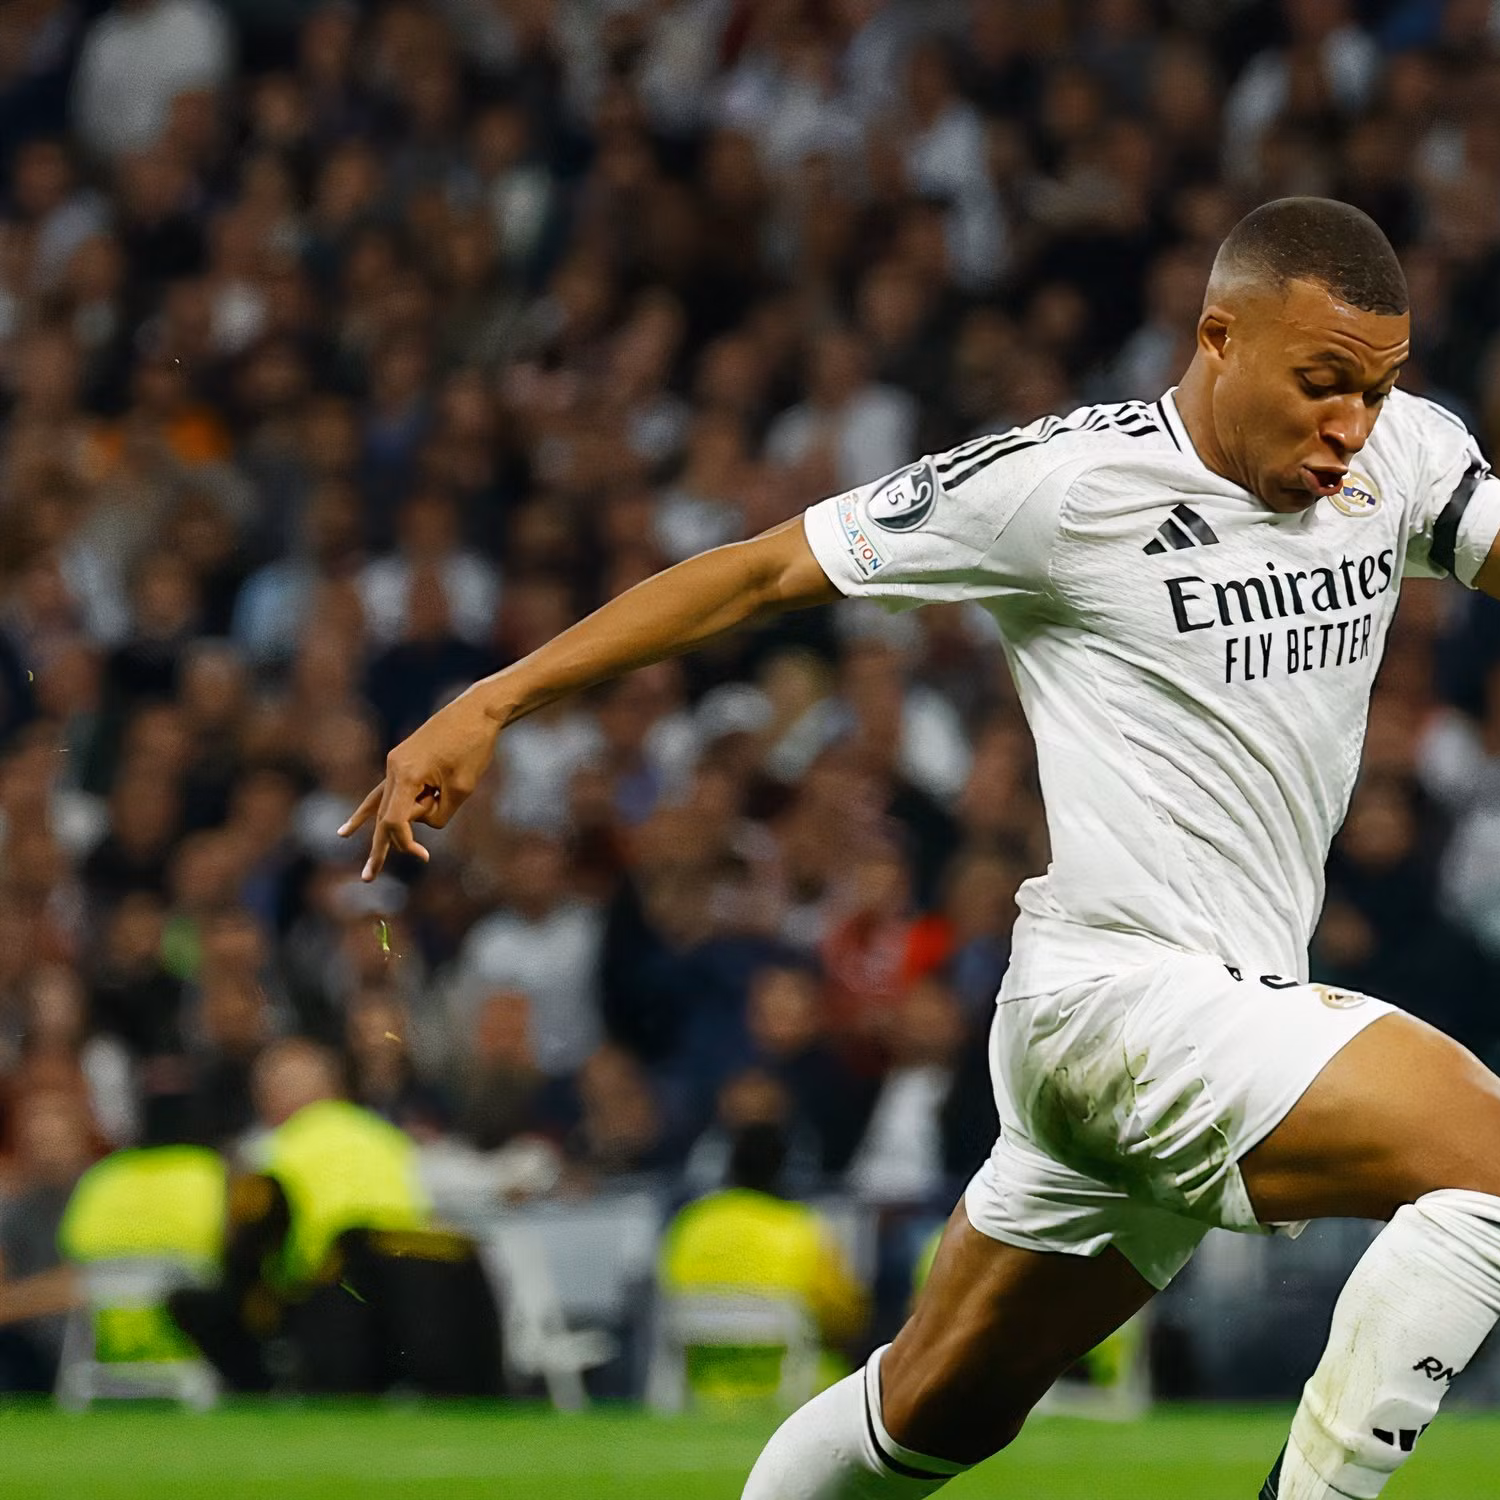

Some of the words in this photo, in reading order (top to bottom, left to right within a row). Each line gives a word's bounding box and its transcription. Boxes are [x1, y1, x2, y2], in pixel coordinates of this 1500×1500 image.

[886, 484, 905, 505] 15
[1163, 549, 1393, 633] Emirates
[1225, 632, 1272, 684] FLY
[1287, 613, 1371, 675] BETTER
